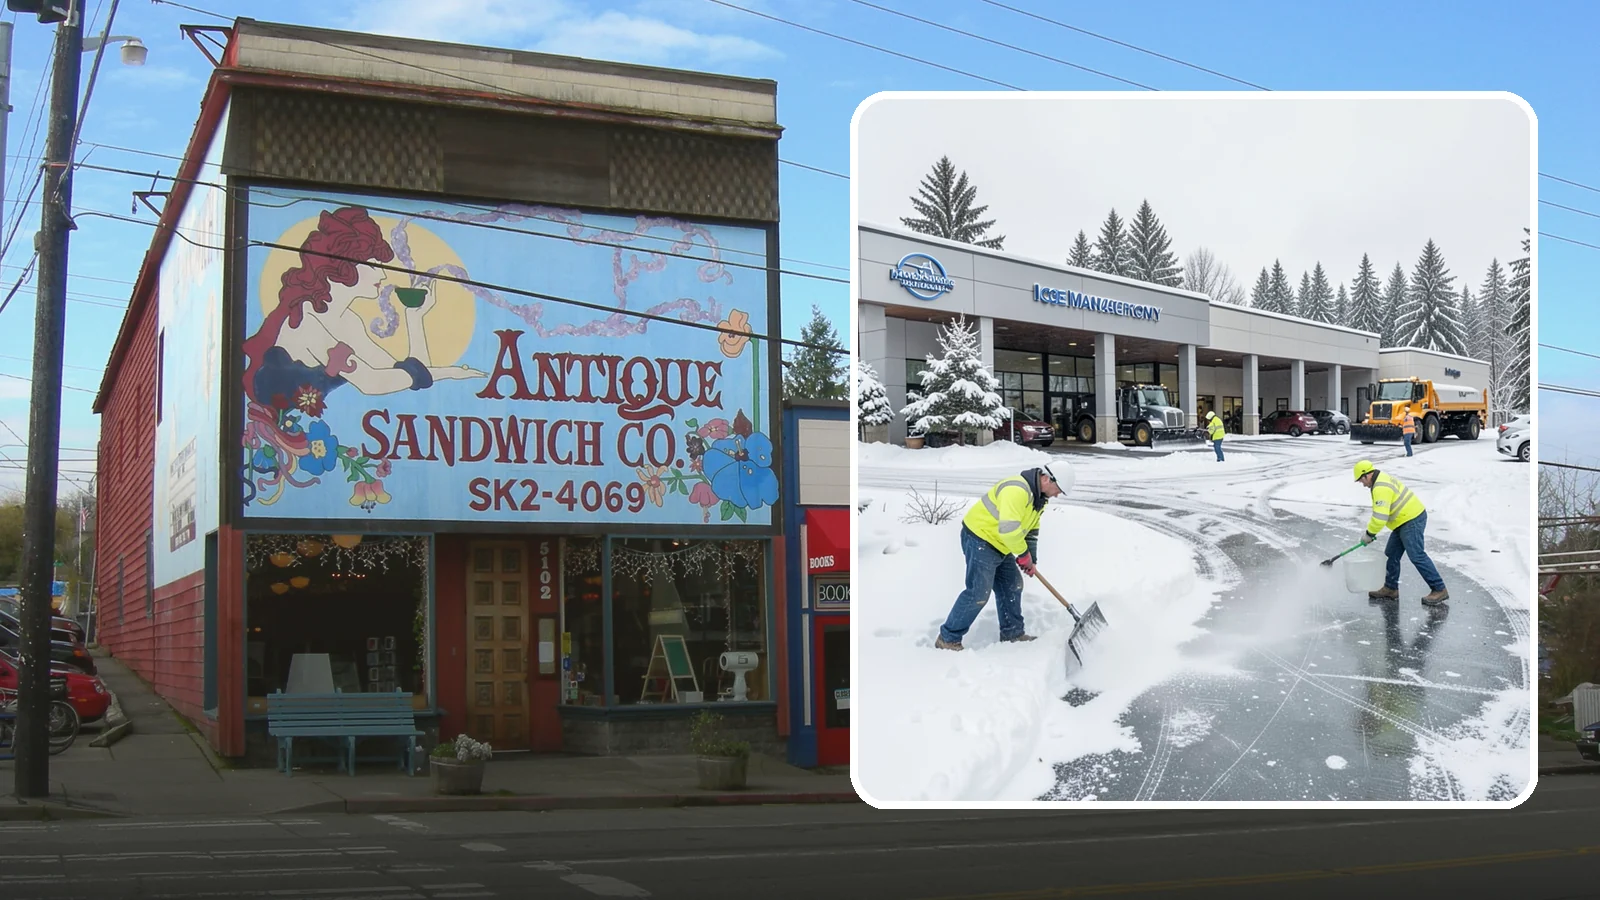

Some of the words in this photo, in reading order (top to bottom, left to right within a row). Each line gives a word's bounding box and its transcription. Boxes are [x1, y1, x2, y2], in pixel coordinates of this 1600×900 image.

[477, 329, 723, 420] ANTIQUE
[362, 409, 603, 467] SANDWICH
[618, 421, 684, 468] CO.
[469, 477, 645, 513] SK2-4069
[540, 542, 551, 599] 5102
[809, 555, 835, 569] BOOKS
